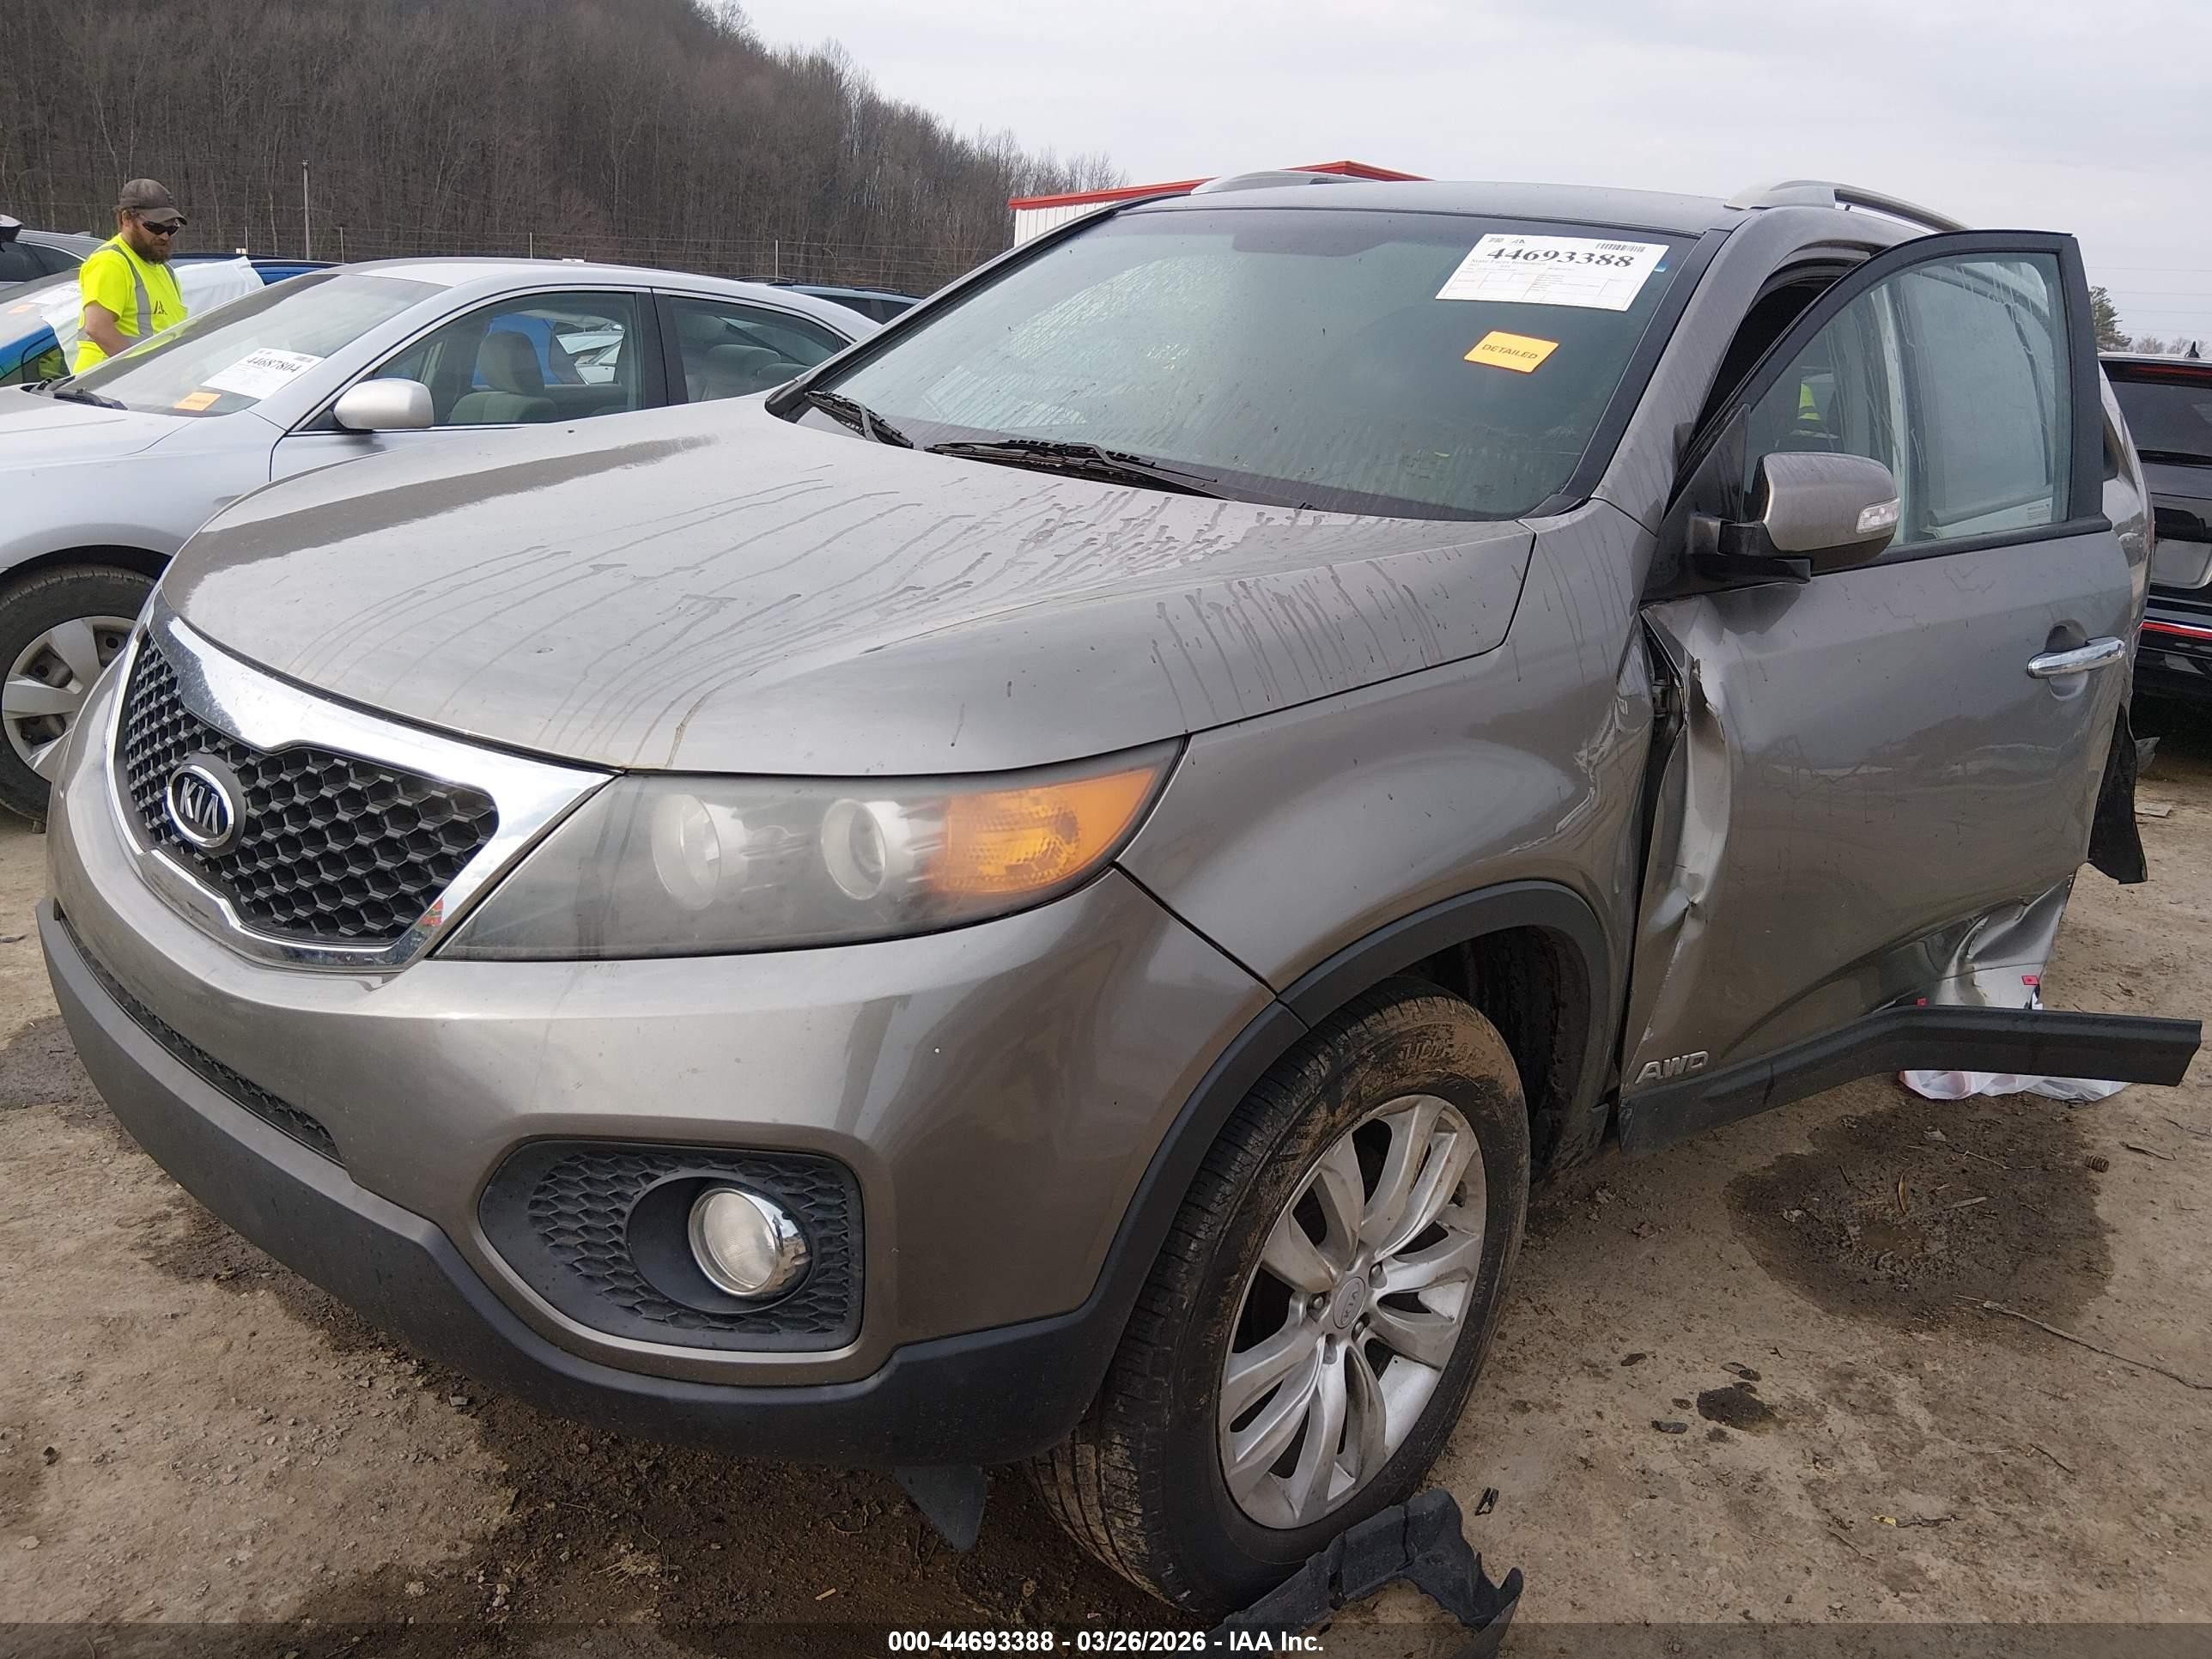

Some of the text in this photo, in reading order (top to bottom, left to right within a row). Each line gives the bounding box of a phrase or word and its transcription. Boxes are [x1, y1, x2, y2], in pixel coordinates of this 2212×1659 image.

[1486, 247, 1635, 268] 44693388
[1480, 343, 1539, 361] DETAILED
[246, 356, 303, 374] 44687804
[179, 776, 220, 836] KIA
[1634, 1050, 1710, 1084] AWD
